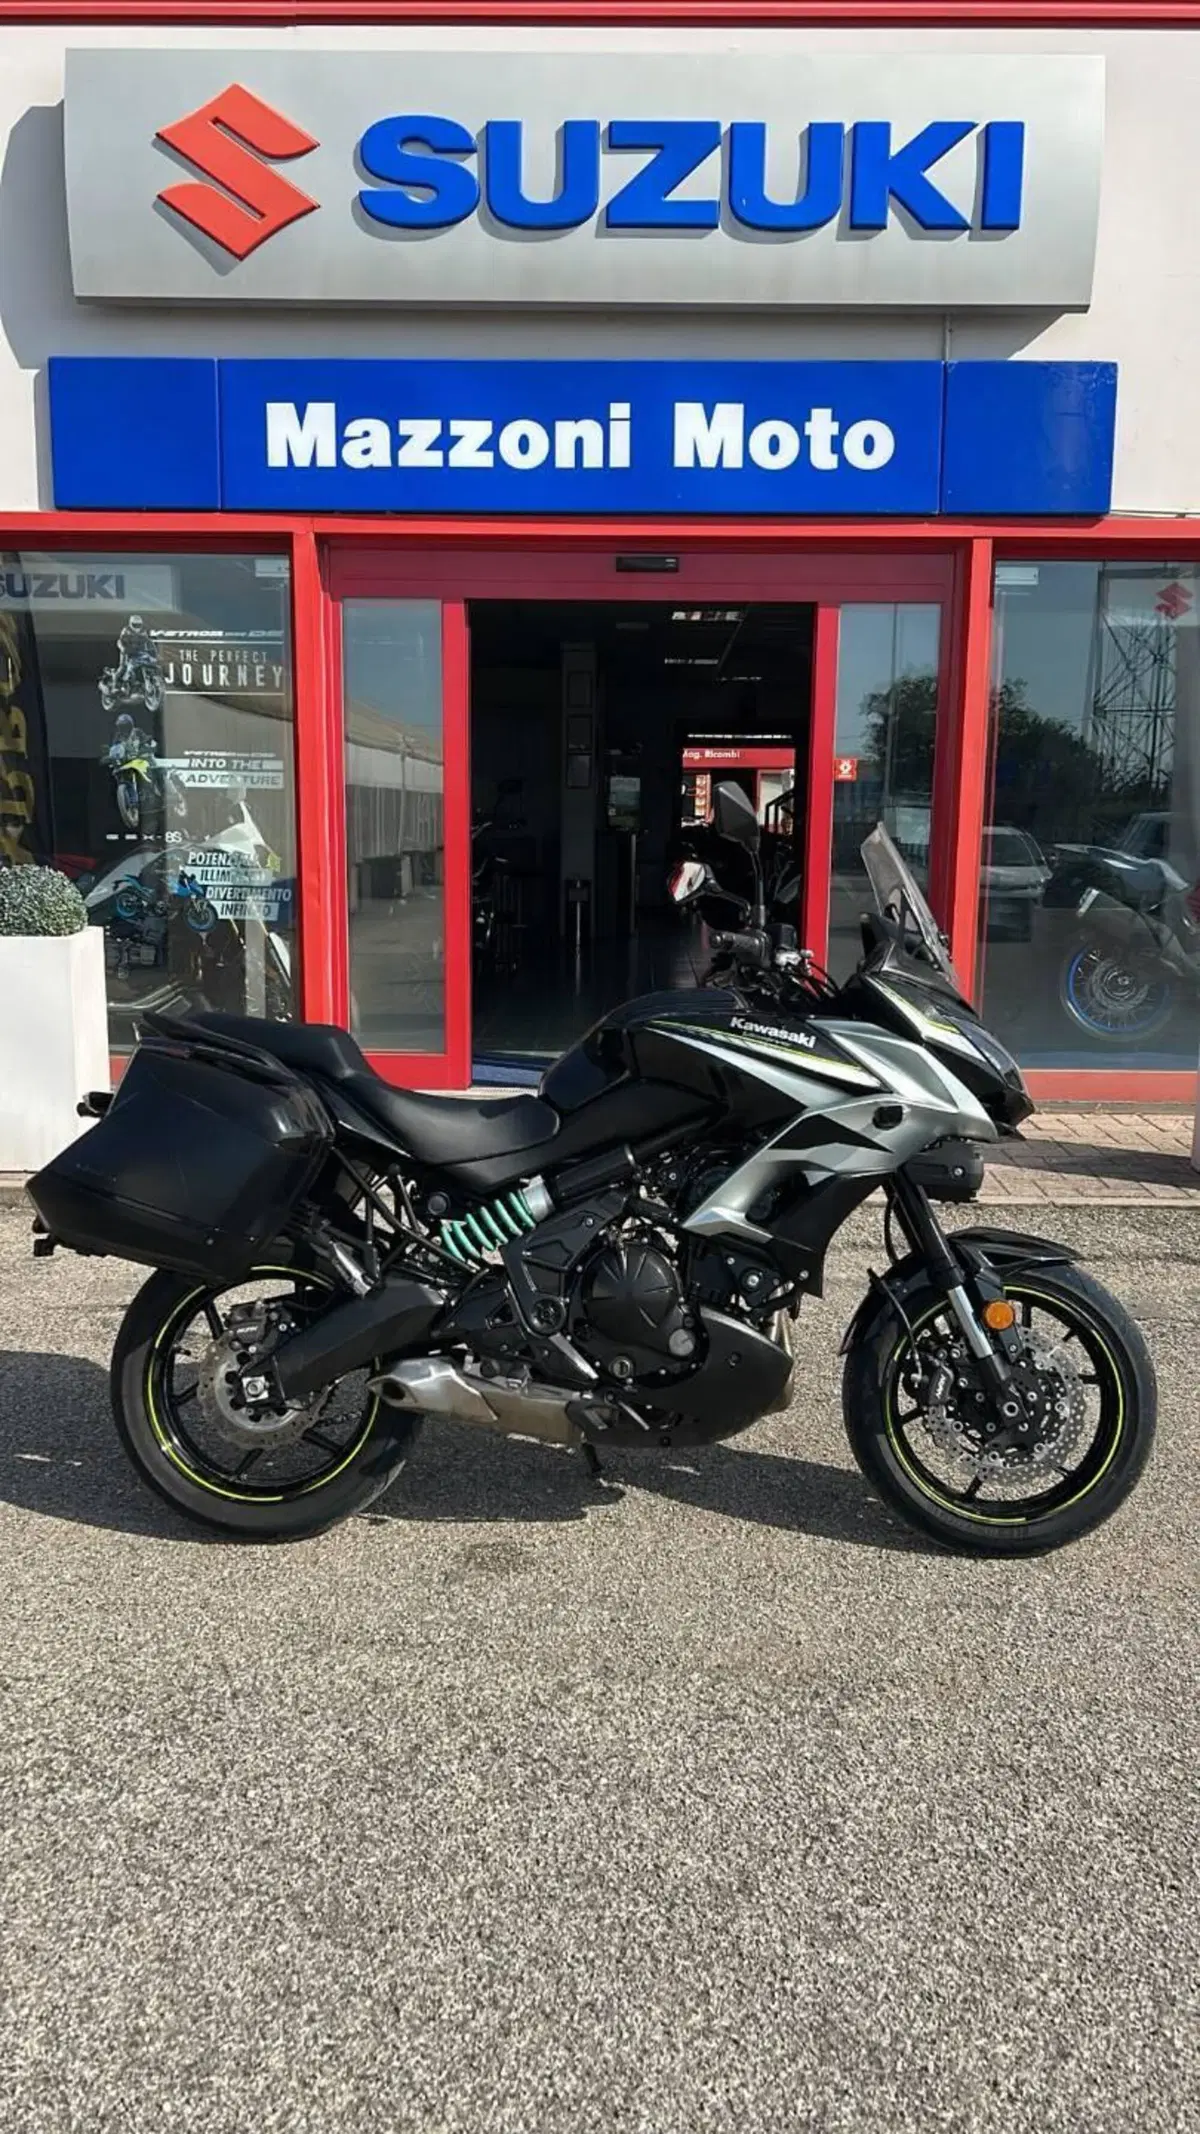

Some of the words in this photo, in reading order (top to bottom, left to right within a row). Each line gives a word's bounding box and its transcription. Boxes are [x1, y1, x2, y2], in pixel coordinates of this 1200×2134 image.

[358, 115, 1025, 231] SUZUKI
[266, 403, 630, 470] Mazzoni
[673, 403, 896, 471] Moto
[180, 649, 199, 661] THE
[210, 649, 267, 663] PERFECT
[164, 662, 282, 688] JOURNEY
[190, 758, 227, 768] INTO
[231, 760, 263, 770] THE
[220, 901, 271, 917] INFIO
[730, 1016, 816, 1049] Kawasaki
